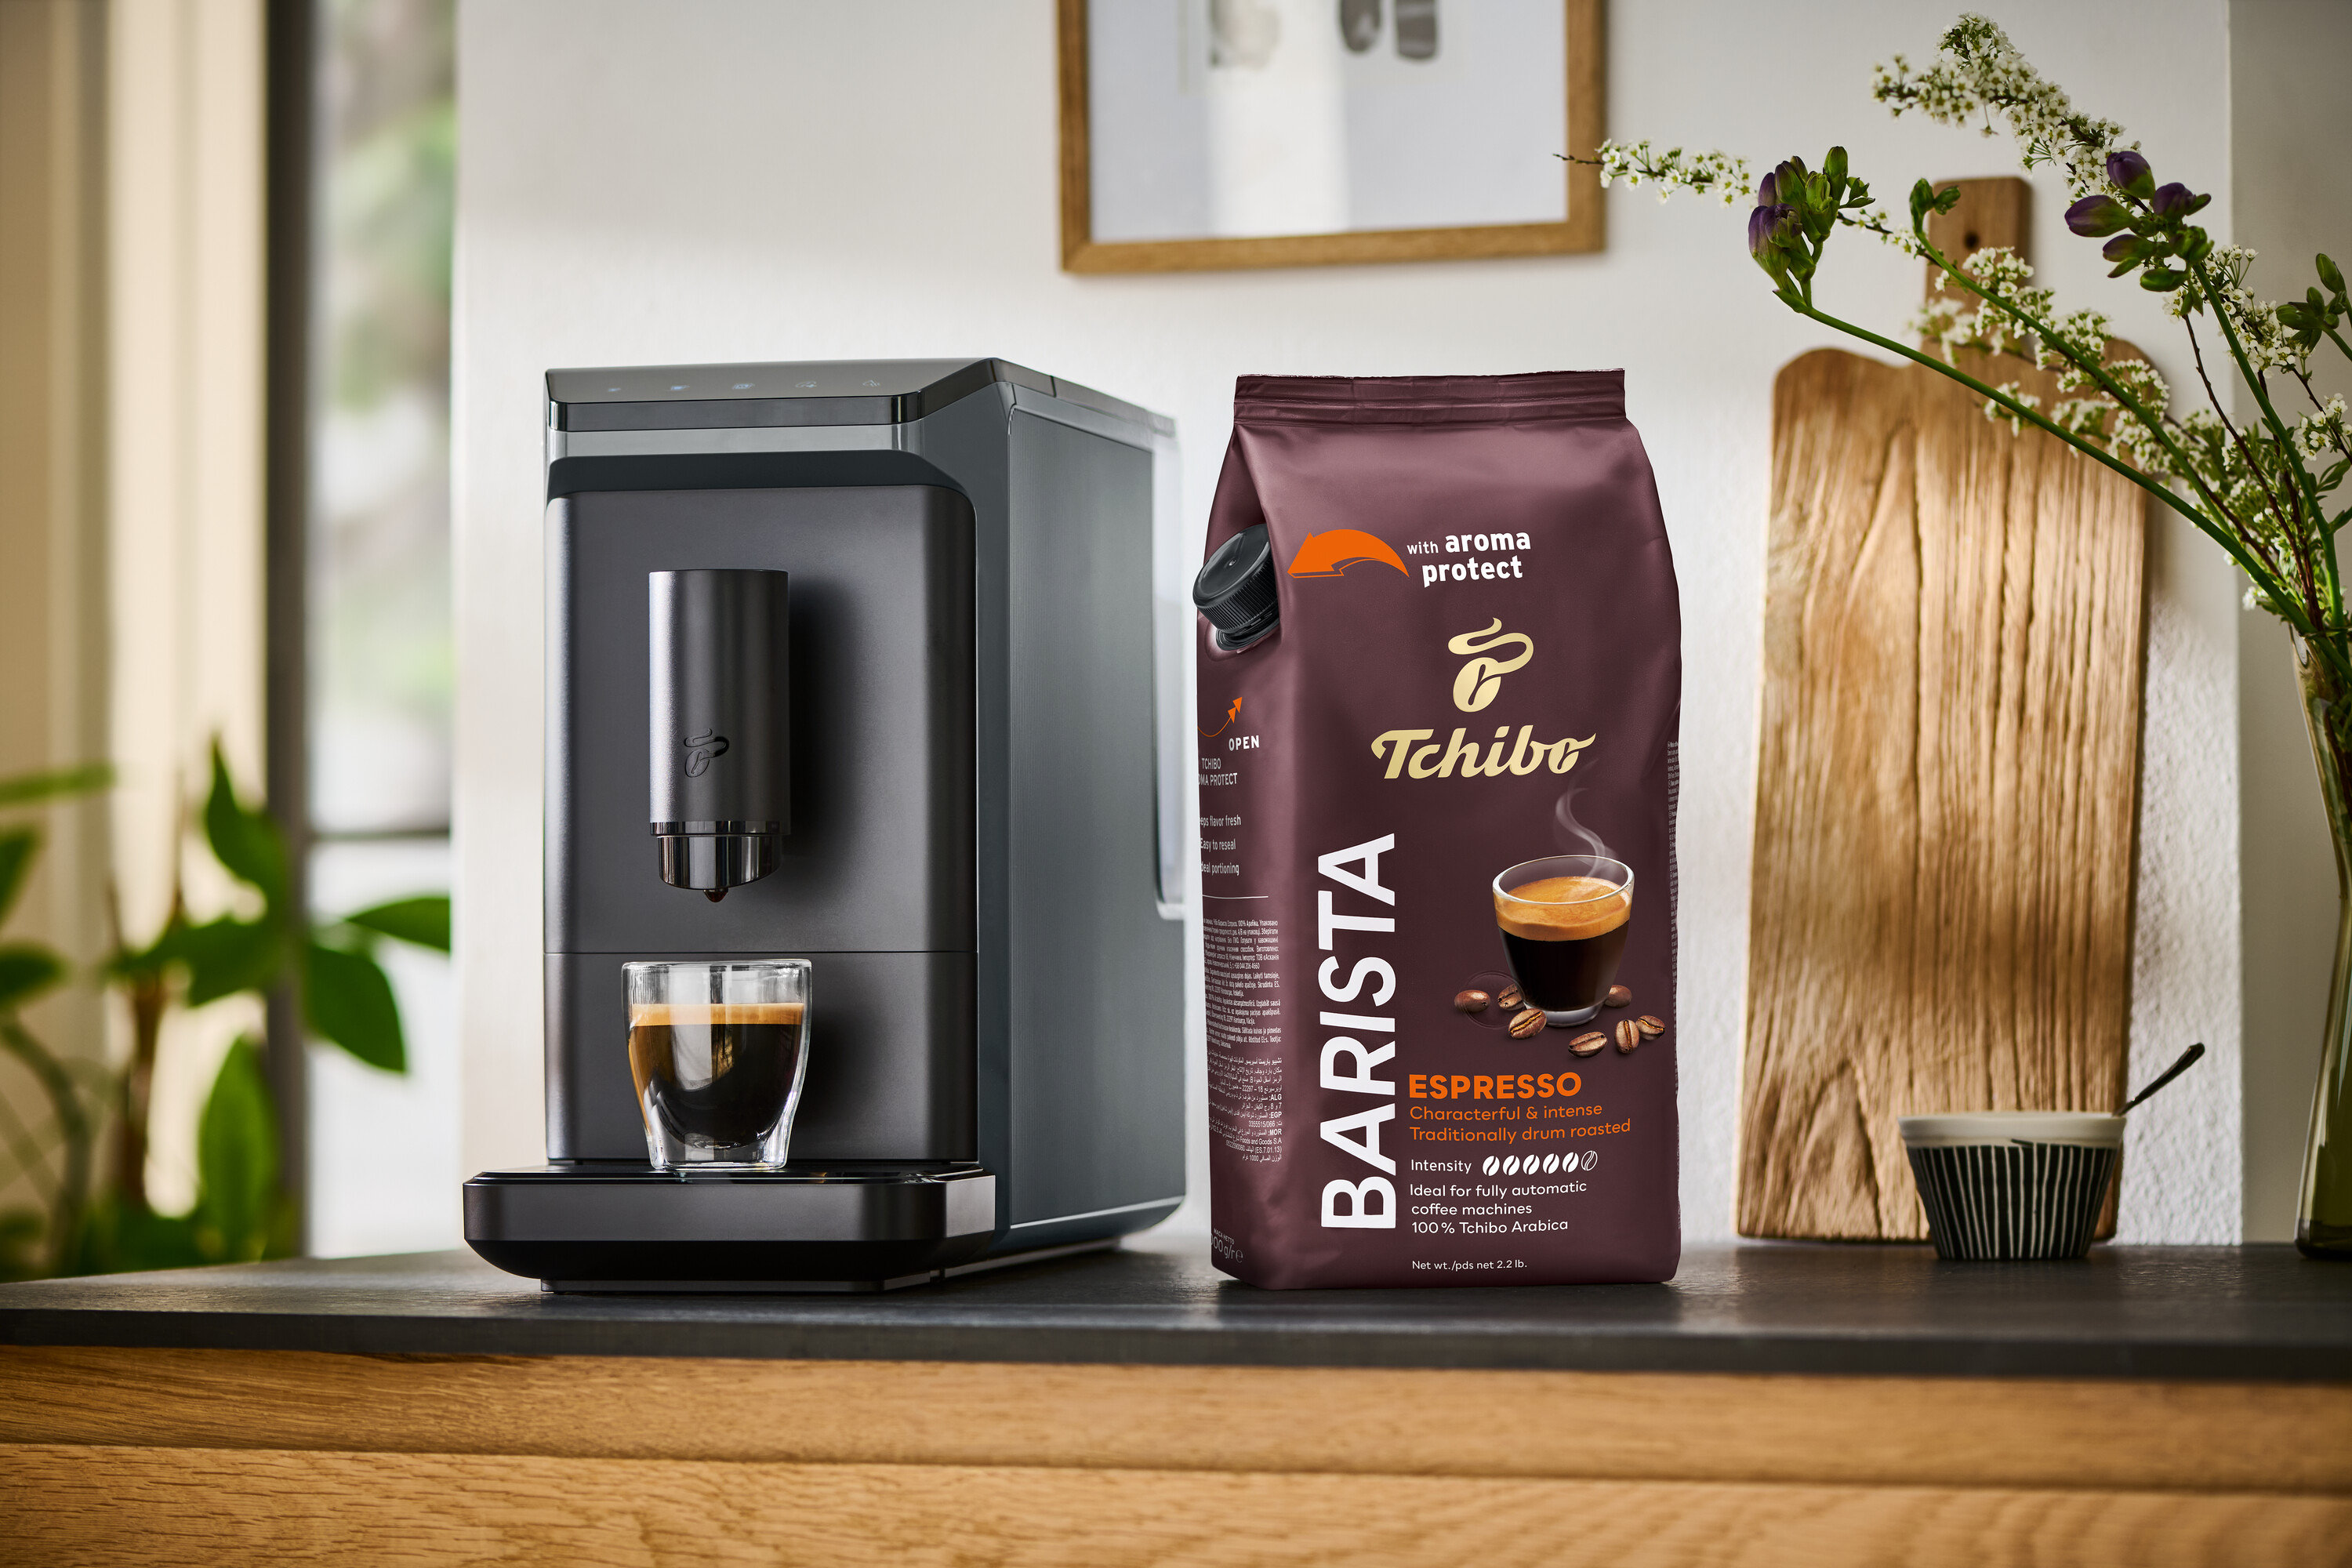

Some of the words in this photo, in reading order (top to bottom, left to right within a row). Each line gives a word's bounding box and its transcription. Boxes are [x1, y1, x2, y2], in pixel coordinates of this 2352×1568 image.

[1406, 541, 1439, 554] with
[1446, 532, 1530, 552] aroma
[1423, 555, 1523, 587] protect
[1229, 735, 1259, 750] OPEN
[1371, 725, 1595, 779] Tchibo
[1201, 757, 1221, 770] TCHIBO
[1210, 772, 1238, 786] PROTECT
[1210, 815, 1225, 826] flavor
[1225, 814, 1242, 826] fresh
[1212, 839, 1218, 850] to
[1219, 838, 1236, 850] reseal
[1211, 862, 1240, 876] portioning
[1318, 833, 1396, 1229] BARISTA
[1409, 1073, 1581, 1099] ESPRESSO
[1409, 1104, 1519, 1123] Characterful
[1526, 1106, 1537, 1119] &
[1544, 1104, 1603, 1118] intense
[1409, 1125, 1516, 1144] Traditionally
[1522, 1127, 1566, 1141] drum
[1570, 1118, 1630, 1138] roasted
[1412, 1160, 1472, 1174] Intensity
[1410, 1184, 1445, 1196] Ideal
[1450, 1185, 1472, 1196] for
[1475, 1185, 1507, 1199] fully
[1512, 1181, 1586, 1196] automatic
[1412, 1203, 1457, 1214] coffee
[1463, 1203, 1532, 1214] machines
[1459, 1222, 1507, 1233] Tchibo
[1512, 1220, 1567, 1232] Arabica
[1413, 1261, 1431, 1269] Net
[1434, 1261, 1473, 1271] wt./pds
